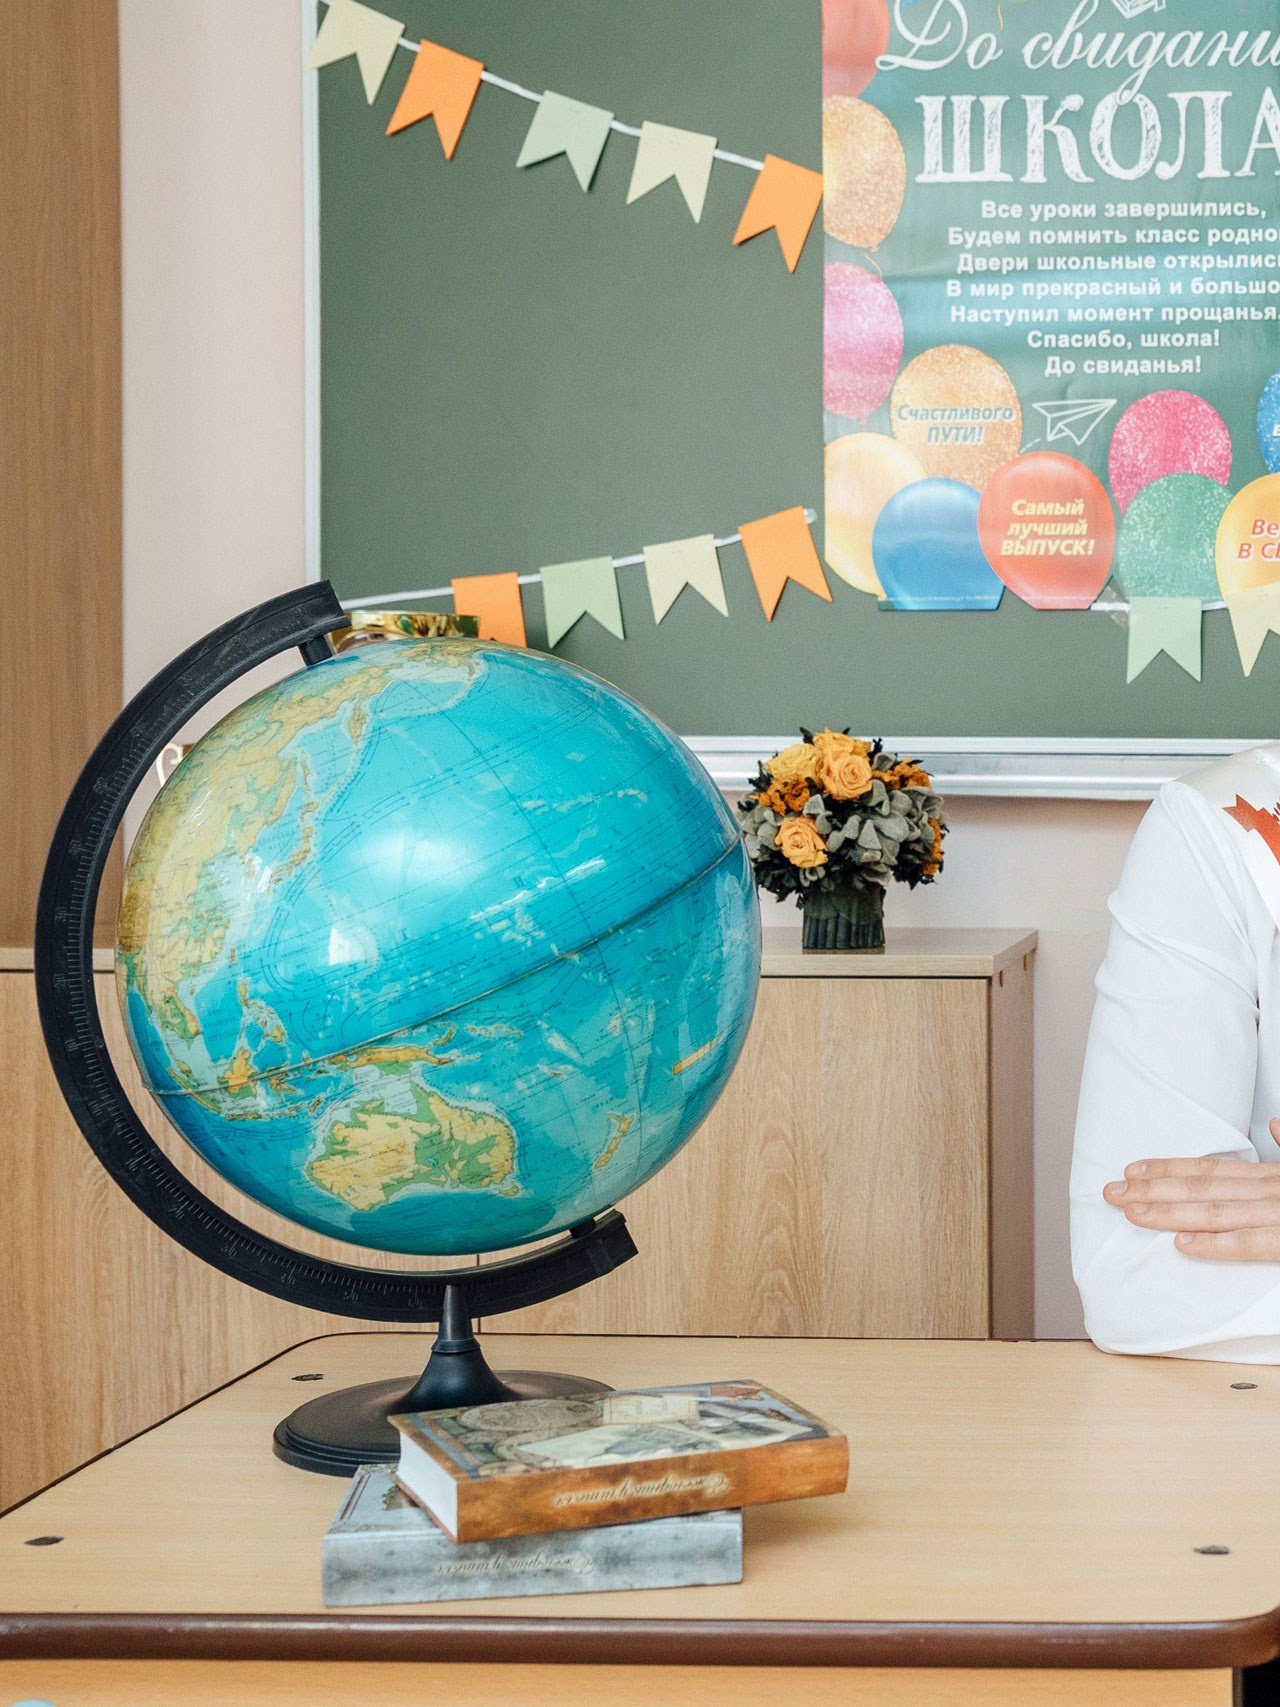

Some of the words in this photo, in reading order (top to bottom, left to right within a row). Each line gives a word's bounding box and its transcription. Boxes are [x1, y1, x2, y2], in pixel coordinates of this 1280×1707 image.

[875, 0, 1002, 70] До
[980, 200, 1023, 218] Все
[1030, 203, 1097, 222] уроки
[1104, 200, 1267, 221] завершились,
[948, 227, 1021, 248] Будем
[1029, 229, 1128, 245] помнить
[1135, 228, 1200, 243] класс
[957, 253, 1029, 275] Двери
[1037, 253, 1156, 271] школьные
[947, 280, 962, 297] В
[970, 282, 1014, 299] мир
[1022, 277, 1161, 299] прекрасный
[1170, 280, 1183, 295] и
[950, 305, 1059, 326] Наступил
[1067, 306, 1153, 322] момент
[1027, 331, 1132, 349] Спасибо,
[1140, 329, 1220, 347] школа!
[1045, 356, 1076, 376] До
[1083, 354, 1202, 376] свиданья!
[896, 404, 1015, 424] Счастливого
[927, 426, 986, 446] ПУТИ!
[1011, 498, 1085, 517] Самый
[1007, 517, 1088, 537] лучший
[1000, 538, 1095, 558] ВЫПУСК!
[1237, 542, 1253, 559] В
